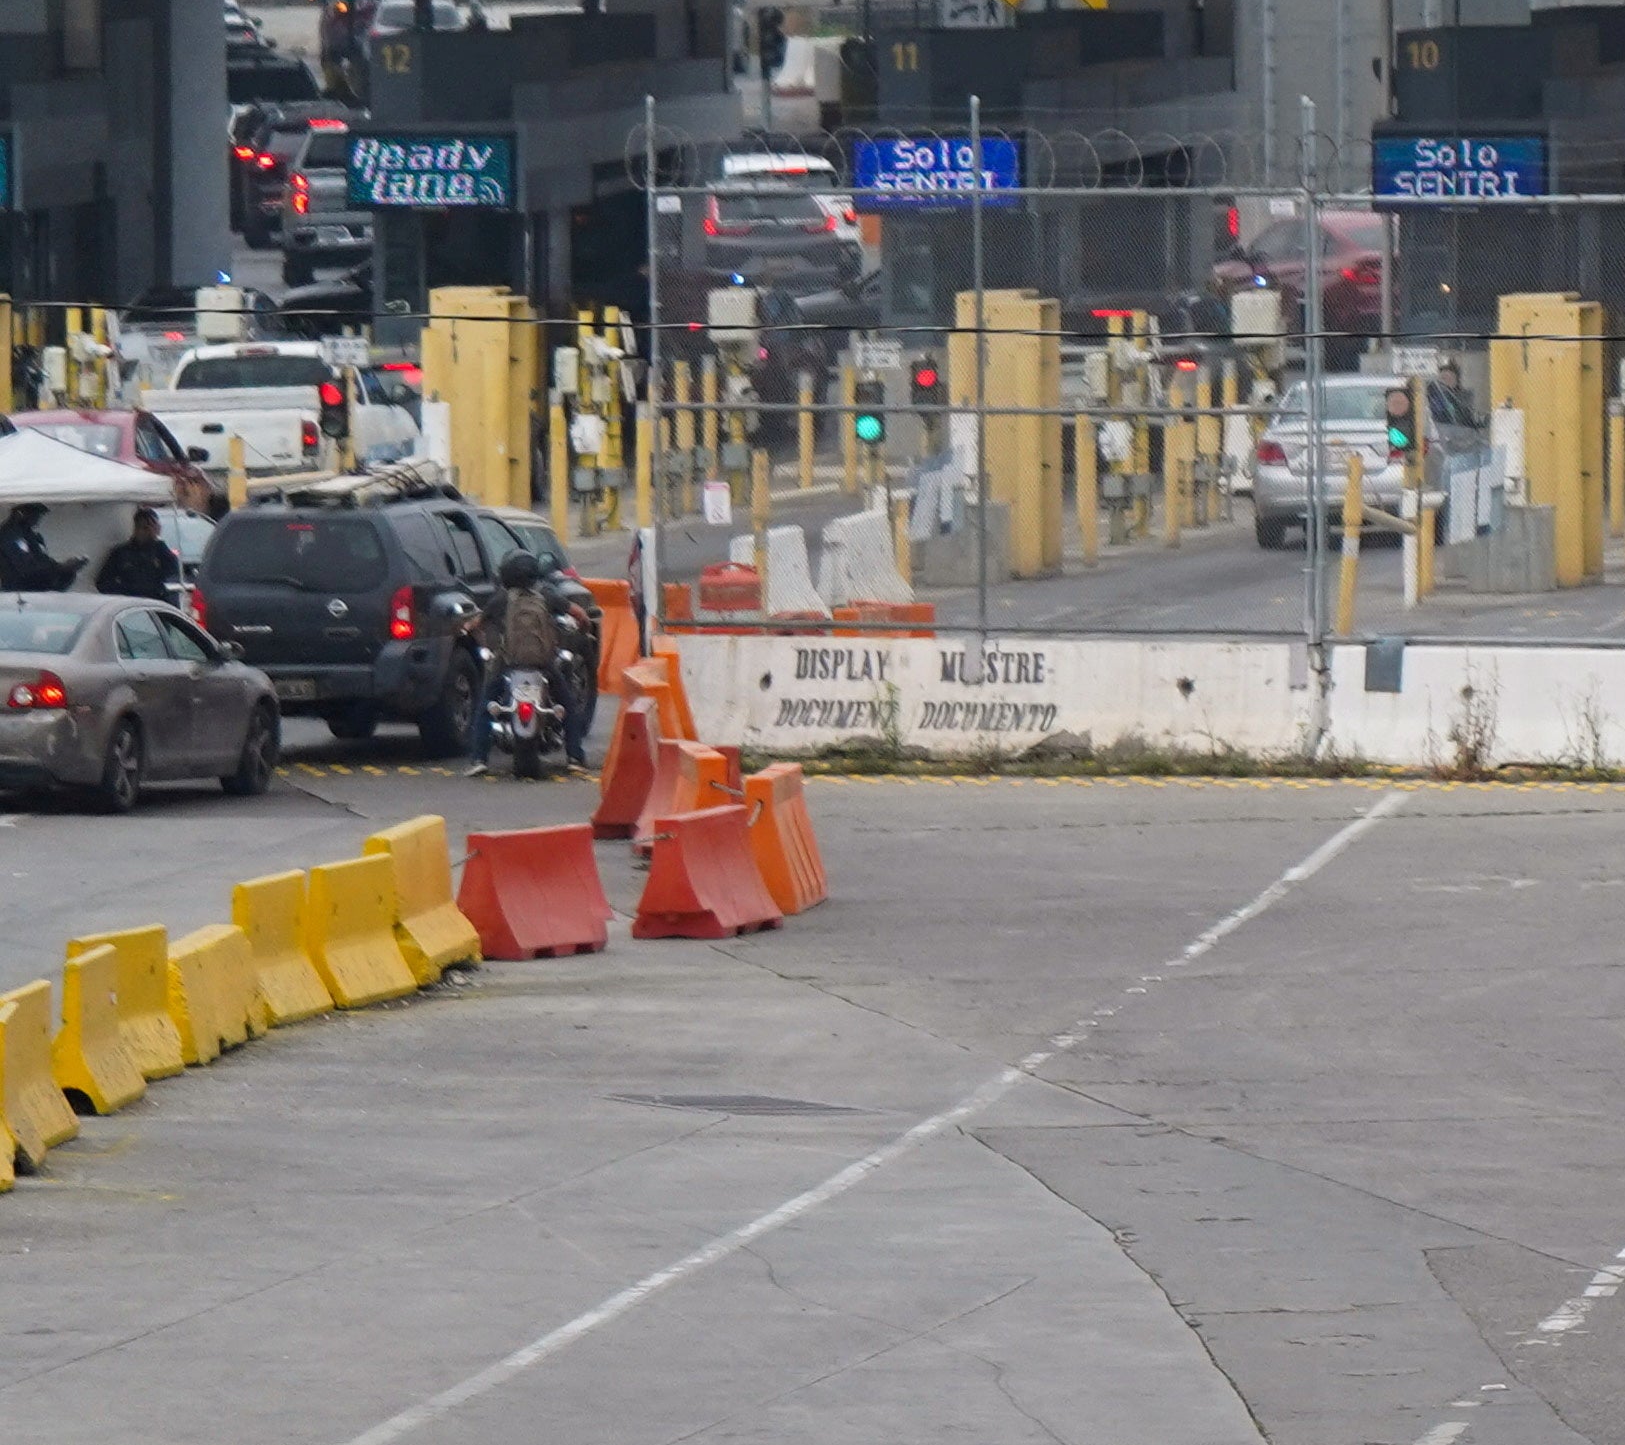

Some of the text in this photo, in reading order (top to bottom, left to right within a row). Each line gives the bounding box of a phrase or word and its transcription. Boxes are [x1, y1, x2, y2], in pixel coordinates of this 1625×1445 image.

[380, 43, 412, 75] 12
[891, 42, 920, 72] 11
[1407, 40, 1440, 69] 10
[891, 141, 976, 169] Solo
[1414, 139, 1498, 168] Solo
[1393, 171, 1521, 198] SENTRI
[795, 648, 1045, 685] DISPLAY MUSTRE
[918, 699, 1058, 733] DOCUMENTO
